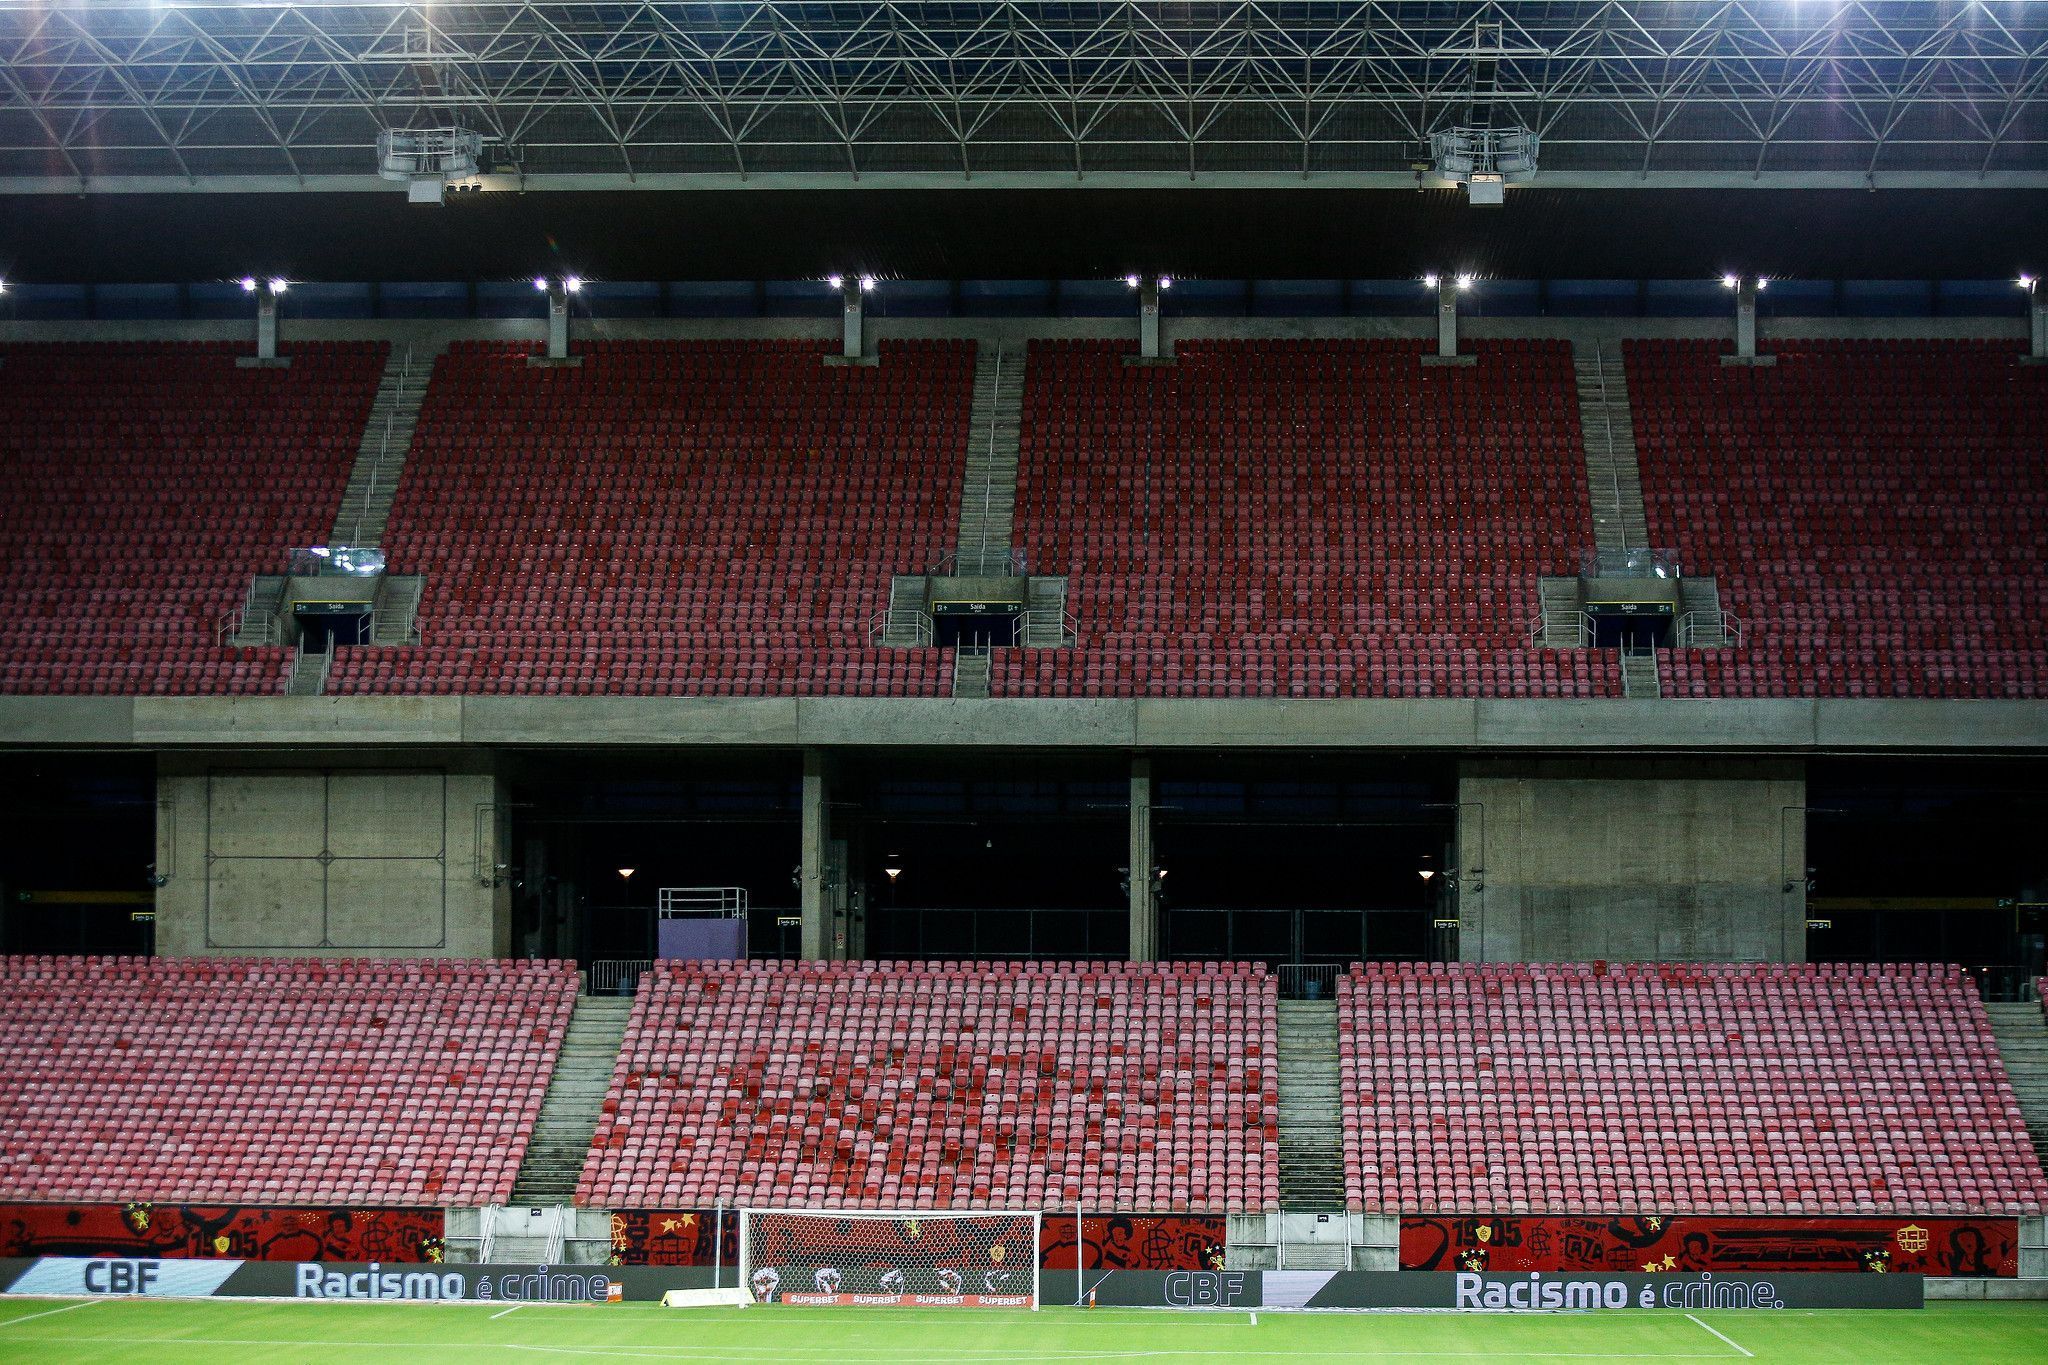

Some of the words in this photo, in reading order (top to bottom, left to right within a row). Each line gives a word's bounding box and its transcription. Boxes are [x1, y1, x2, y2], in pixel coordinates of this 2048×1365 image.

[1452, 1218, 1522, 1247] 1905
[1899, 1240, 1927, 1250] 1905
[84, 1260, 160, 1294] CBF
[296, 1262, 466, 1299] Racismo
[477, 1275, 493, 1300] é
[1164, 1271, 1244, 1307] CBF
[1456, 1271, 1628, 1309] Racismo
[1639, 1284, 1655, 1308] é
[1663, 1271, 1784, 1309] crime.
[790, 1294, 839, 1304] SUPERBET
[854, 1294, 902, 1304] SUPERBET
[915, 1295, 964, 1305] SUPERBET
[978, 1295, 1028, 1305] SUPERBET
